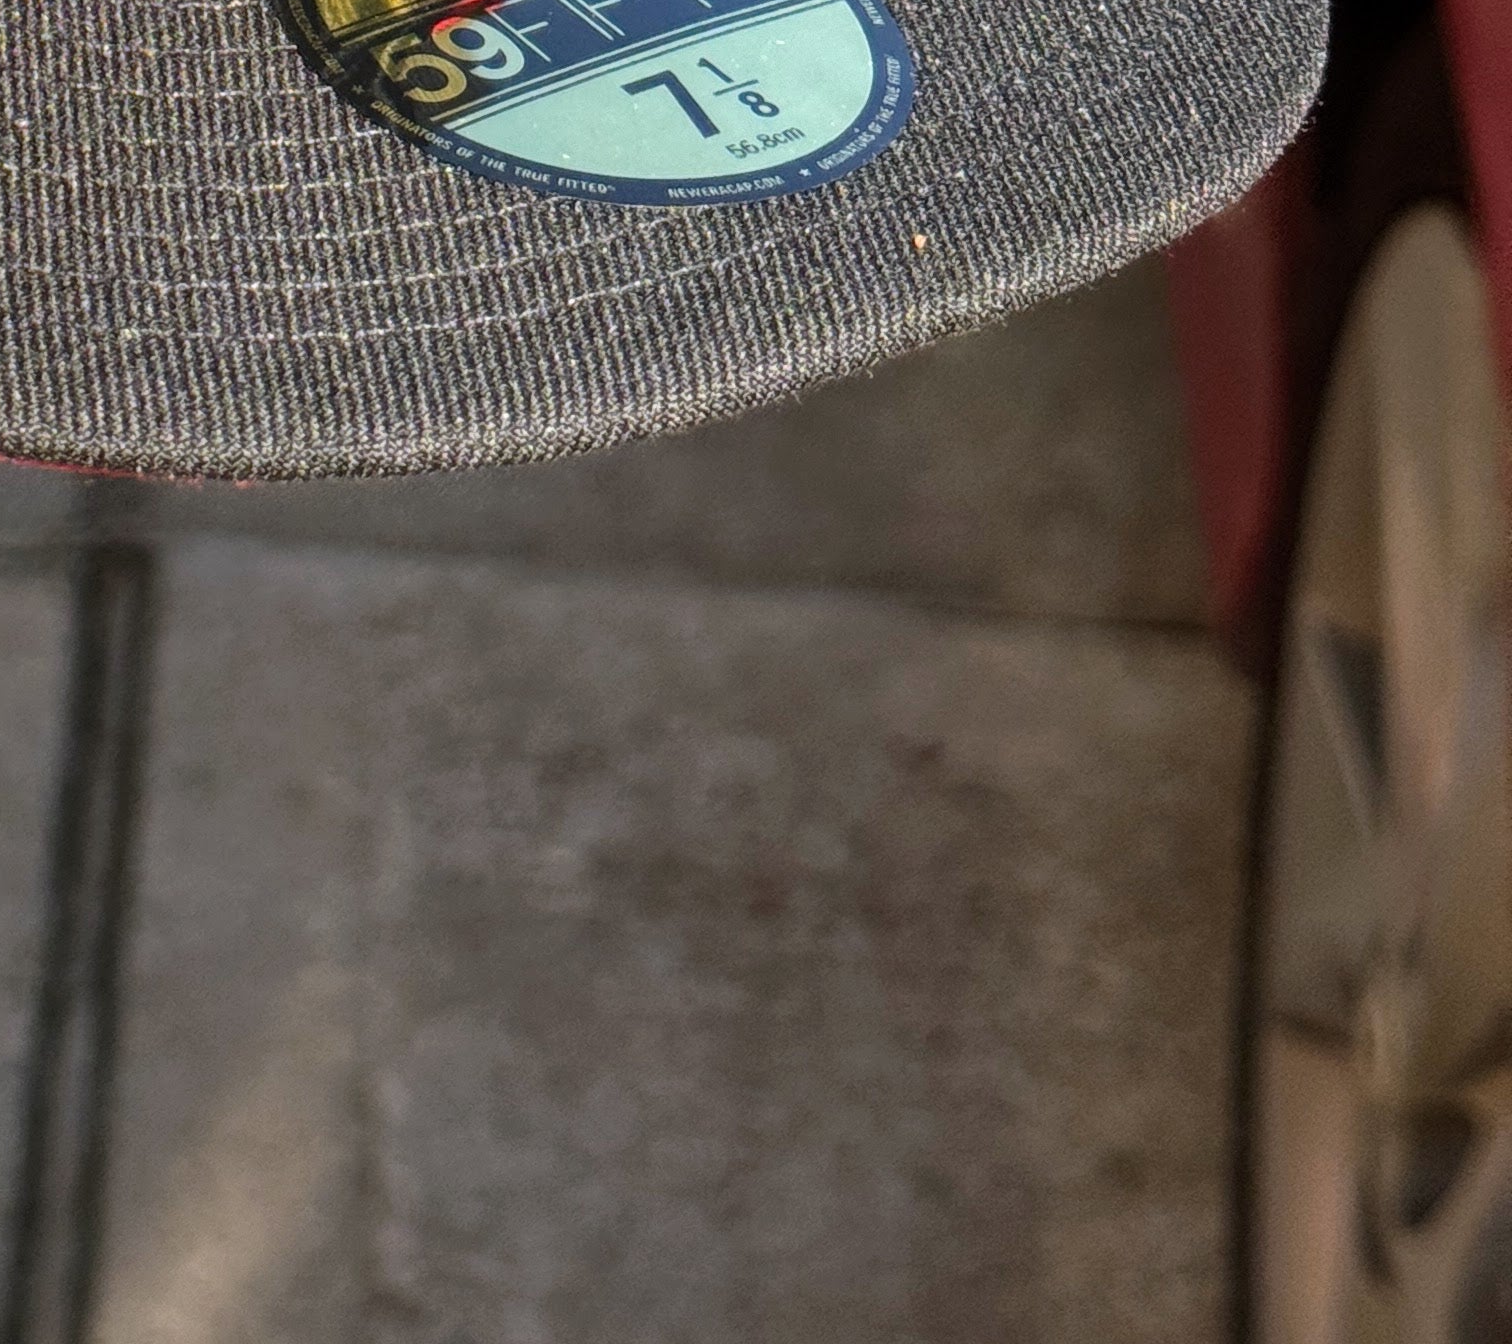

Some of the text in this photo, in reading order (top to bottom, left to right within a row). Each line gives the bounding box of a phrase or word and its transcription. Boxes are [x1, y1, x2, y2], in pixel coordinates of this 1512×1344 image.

[620, 69, 721, 139] 7
[370, 100, 453, 151] ORIGINATORS
[456, 145, 476, 160] OF
[480, 154, 506, 173] THE
[514, 165, 551, 184] TRUE
[725, 127, 806, 159] 56.8cm
[667, 174, 786, 200] NEWERACAP.COM
